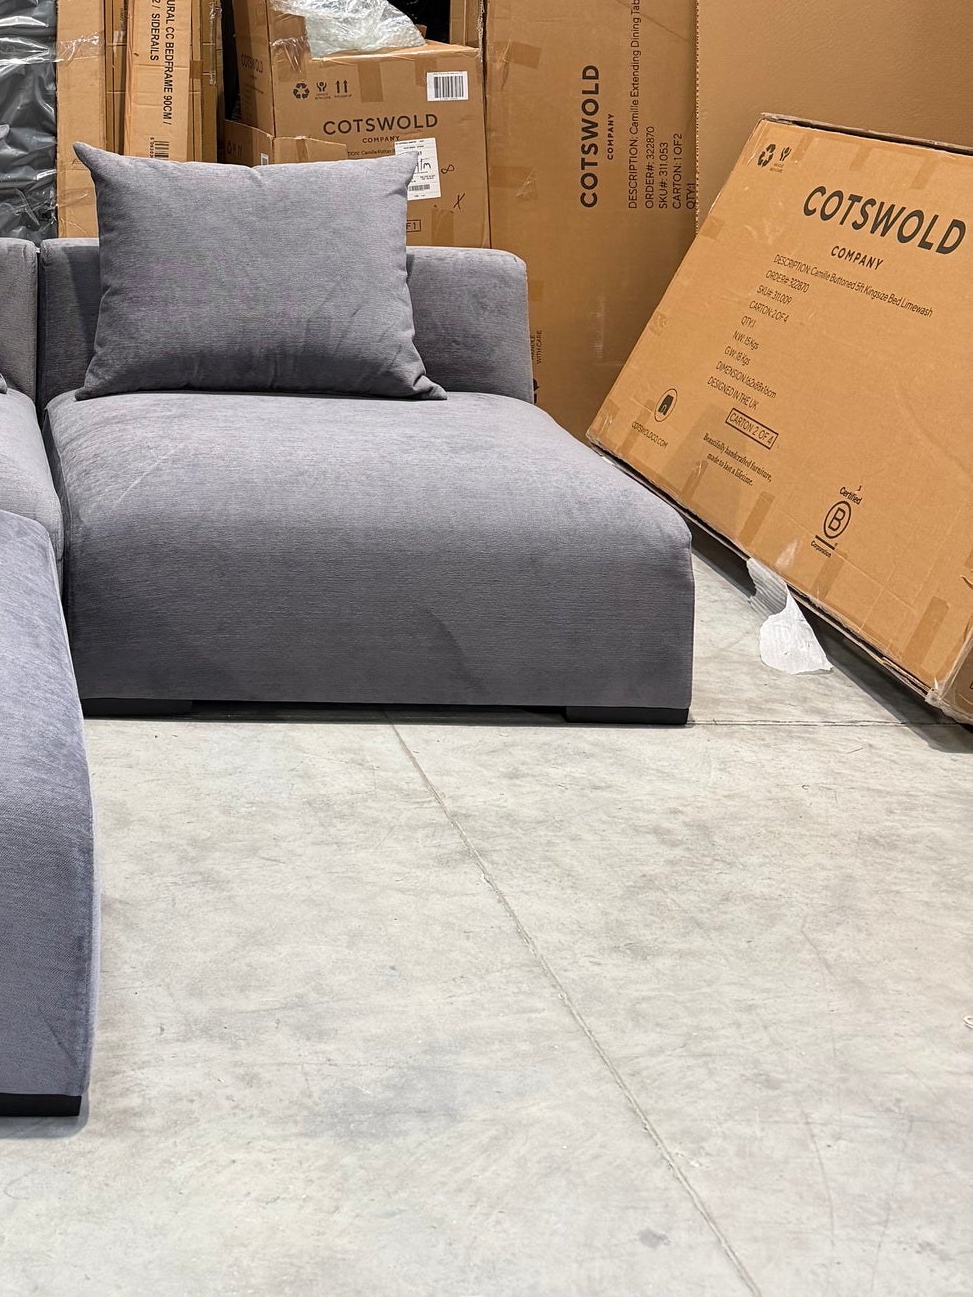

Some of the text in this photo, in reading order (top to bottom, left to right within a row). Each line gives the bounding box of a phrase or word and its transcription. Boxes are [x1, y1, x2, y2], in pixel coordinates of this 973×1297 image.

[149, 13, 160, 61] SIDERAILS
[165, 27, 174, 40] CC
[630, 17, 642, 48] Dining
[163, 41, 173, 93] BEDFRAME
[630, 50, 642, 98] Extending
[162, 94, 172, 119] 90CM
[323, 114, 438, 135] COTSWOLD
[629, 99, 640, 135] Camille
[362, 136, 400, 144] COMPANY
[580, 65, 600, 208] COTSWOLD
[607, 113, 615, 161] COMPANY
[628, 136, 638, 209] DESCRIPTION:
[645, 126, 655, 209] ORDER#: 322870
[658, 142, 669, 209] SKU#: 311.053
[672, 163, 682, 209] CARTON:
[803, 186, 966, 255] COTSWOLD
[831, 245, 884, 270] COMPANY
[773, 254, 933, 318] DESCRIPTION: Camille Buttoned 5ft Kingsize Bed Limewash
[788, 277, 810, 293] 322870
[707, 376, 734, 397] DESIGNED
[738, 392, 749, 405] THE
[748, 400, 759, 410] UK
[729, 412, 775, 445] CARTON 2 OF 4
[703, 433, 772, 483] Beautifully handcrafted furniture,
[706, 453, 720, 465] made
[724, 462, 733, 474] last
[734, 468, 754, 487] lifetime.
[839, 486, 863, 505] Certified
[828, 507, 846, 531] B
